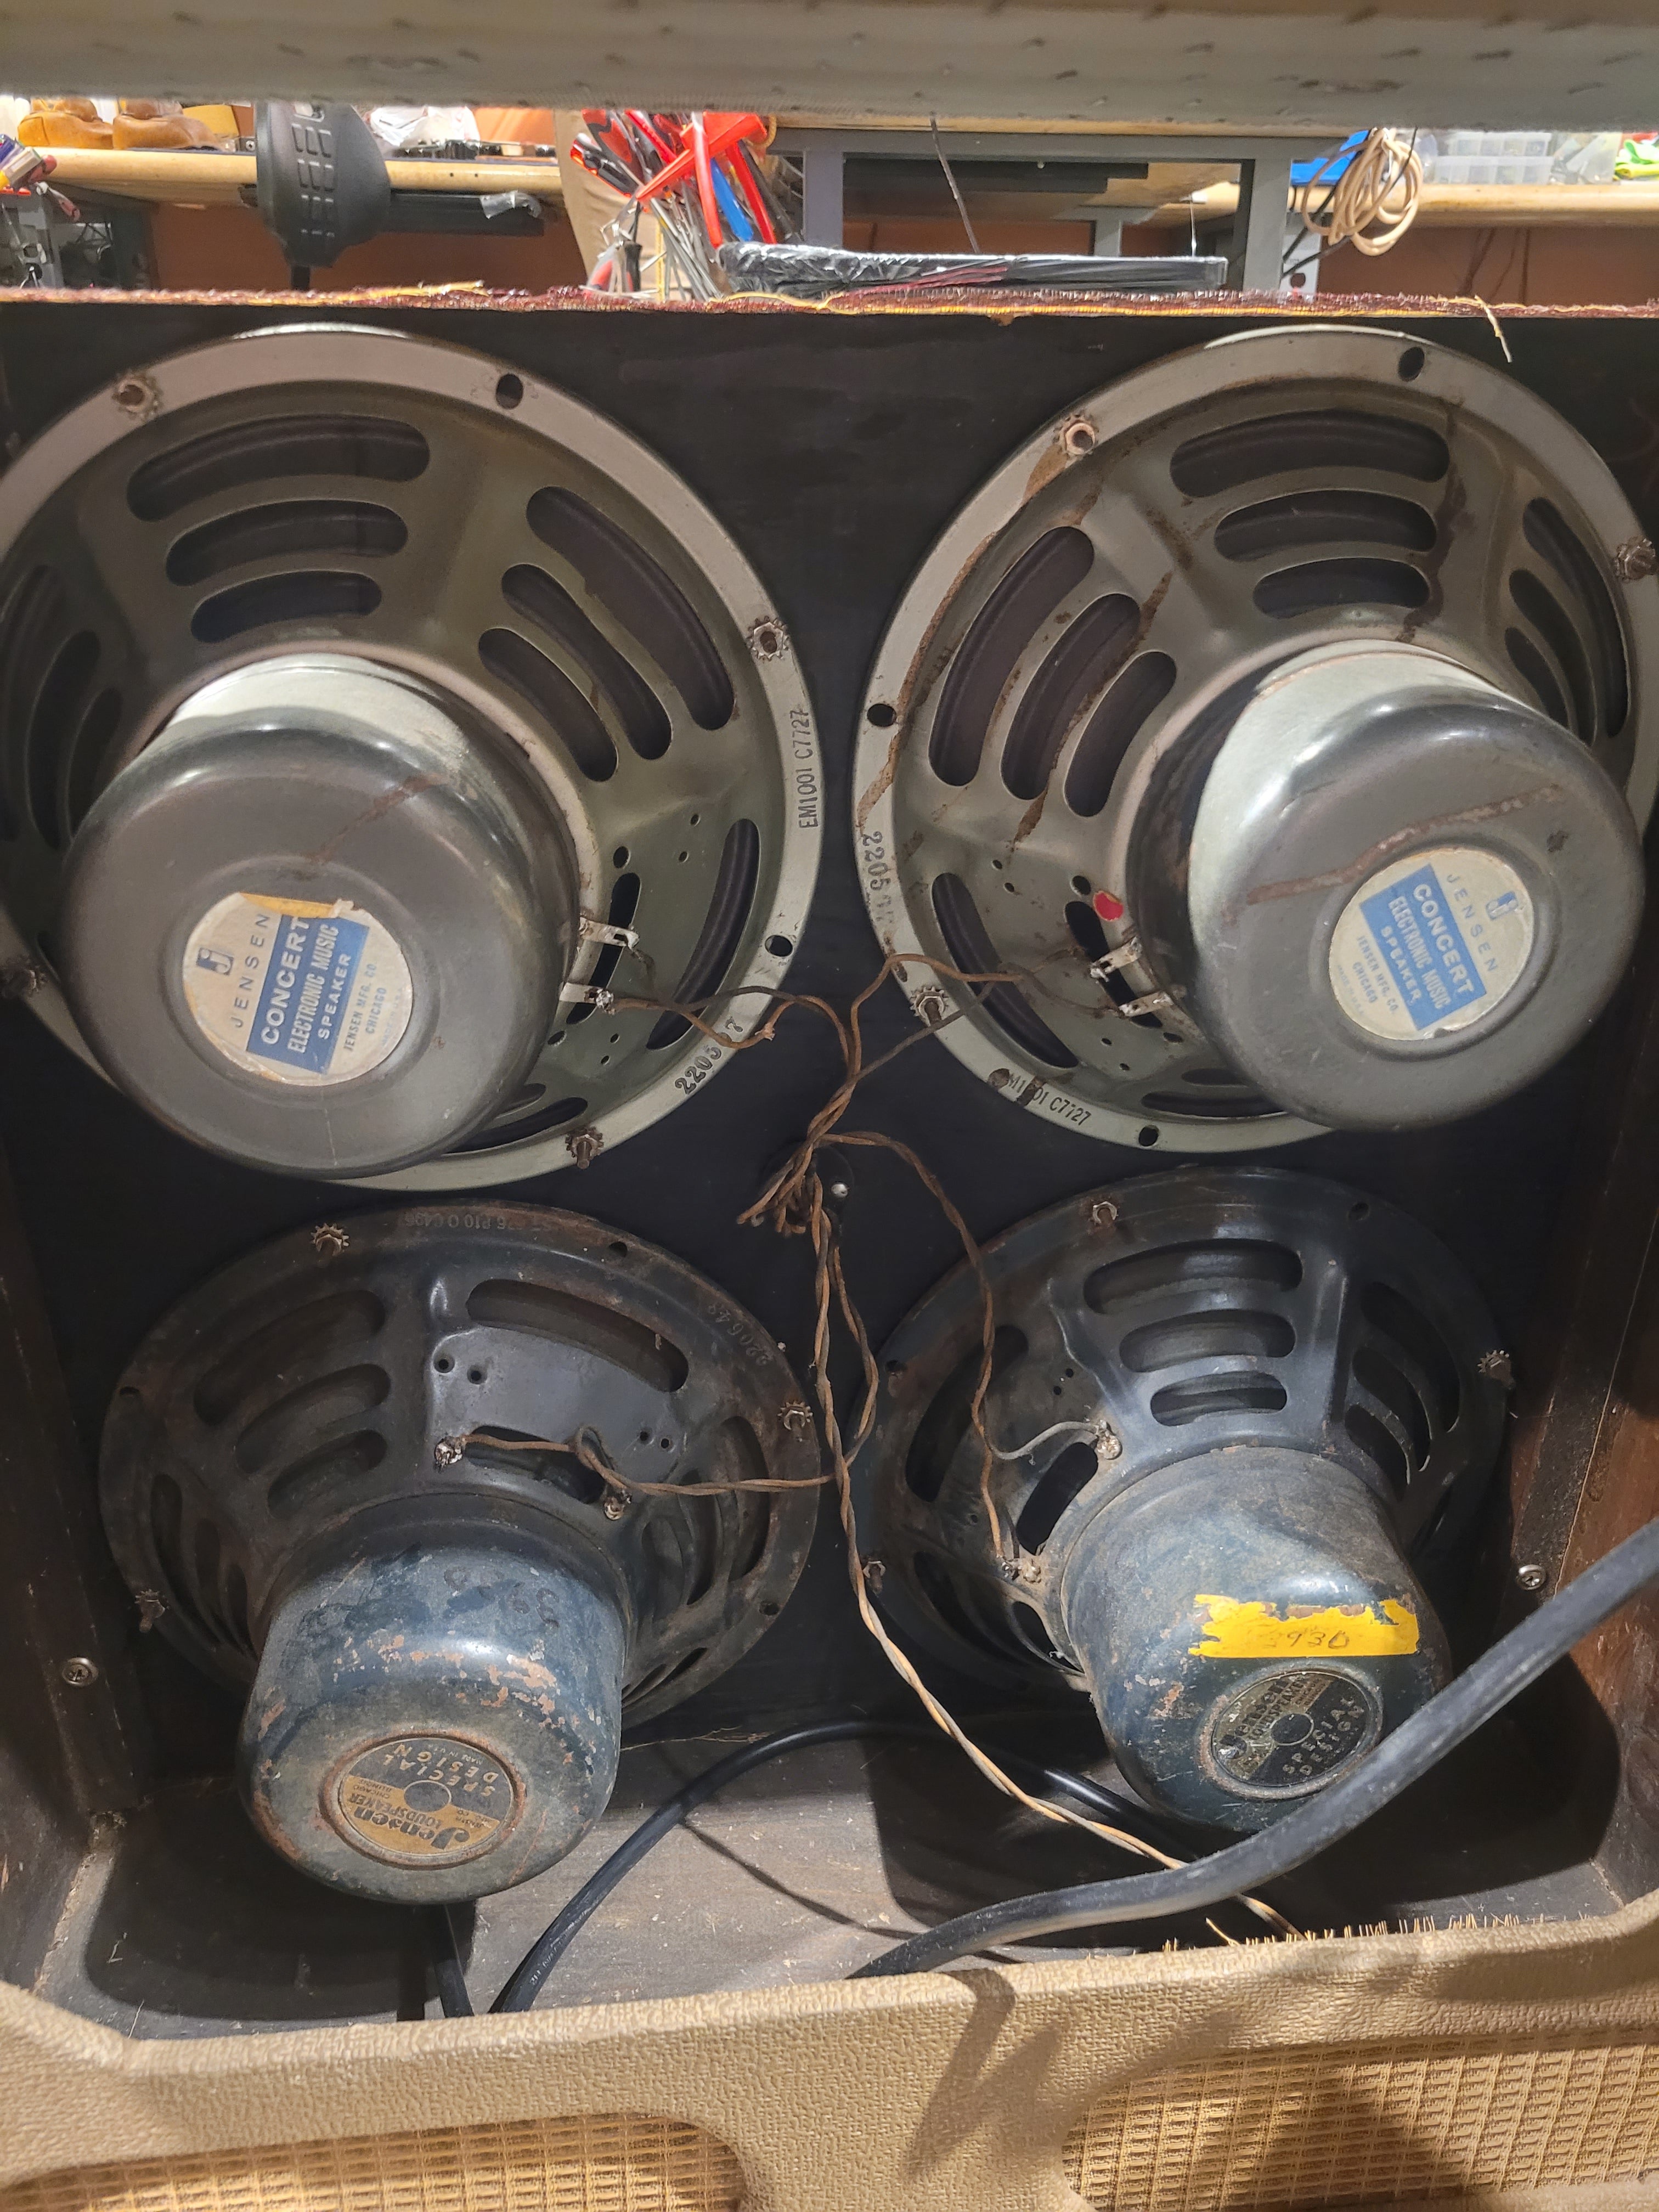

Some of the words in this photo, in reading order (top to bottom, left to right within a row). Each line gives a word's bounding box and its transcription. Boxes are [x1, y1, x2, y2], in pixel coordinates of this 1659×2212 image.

[789, 709, 813, 759] C7727
[1357, 936, 1379, 972] JENSEN
[1388, 896, 1433, 968] ELECTRONIC
[1421, 967, 1453, 1010] MUSIC
[1413, 883, 1475, 995] CONCERT
[1447, 874, 1498, 972] JENSEN
[229, 913, 270, 1028] JENSEN
[261, 917, 312, 1045] CONCERT
[288, 973, 325, 1054] ELECTRONIC
[316, 923, 340, 971] MUSIC
[317, 952, 352, 1040] SPEAKER
[1352, 962, 1378, 1003] CHICAGO
[1381, 926, 1421, 1004] SPEAKER
[343, 1009, 363, 1051] JENSEN
[365, 987, 387, 1035] CHICAGO
[393, 1743, 499, 1783] DESIGN
[1282, 1696, 1354, 1775] SPECIAL
[1299, 1705, 1365, 1776] DESIGN
[348, 1793, 442, 1829] LOUDSPEAKER
[383, 1754, 495, 1797] SPECIAL
[354, 1805, 470, 1850] Jensen
